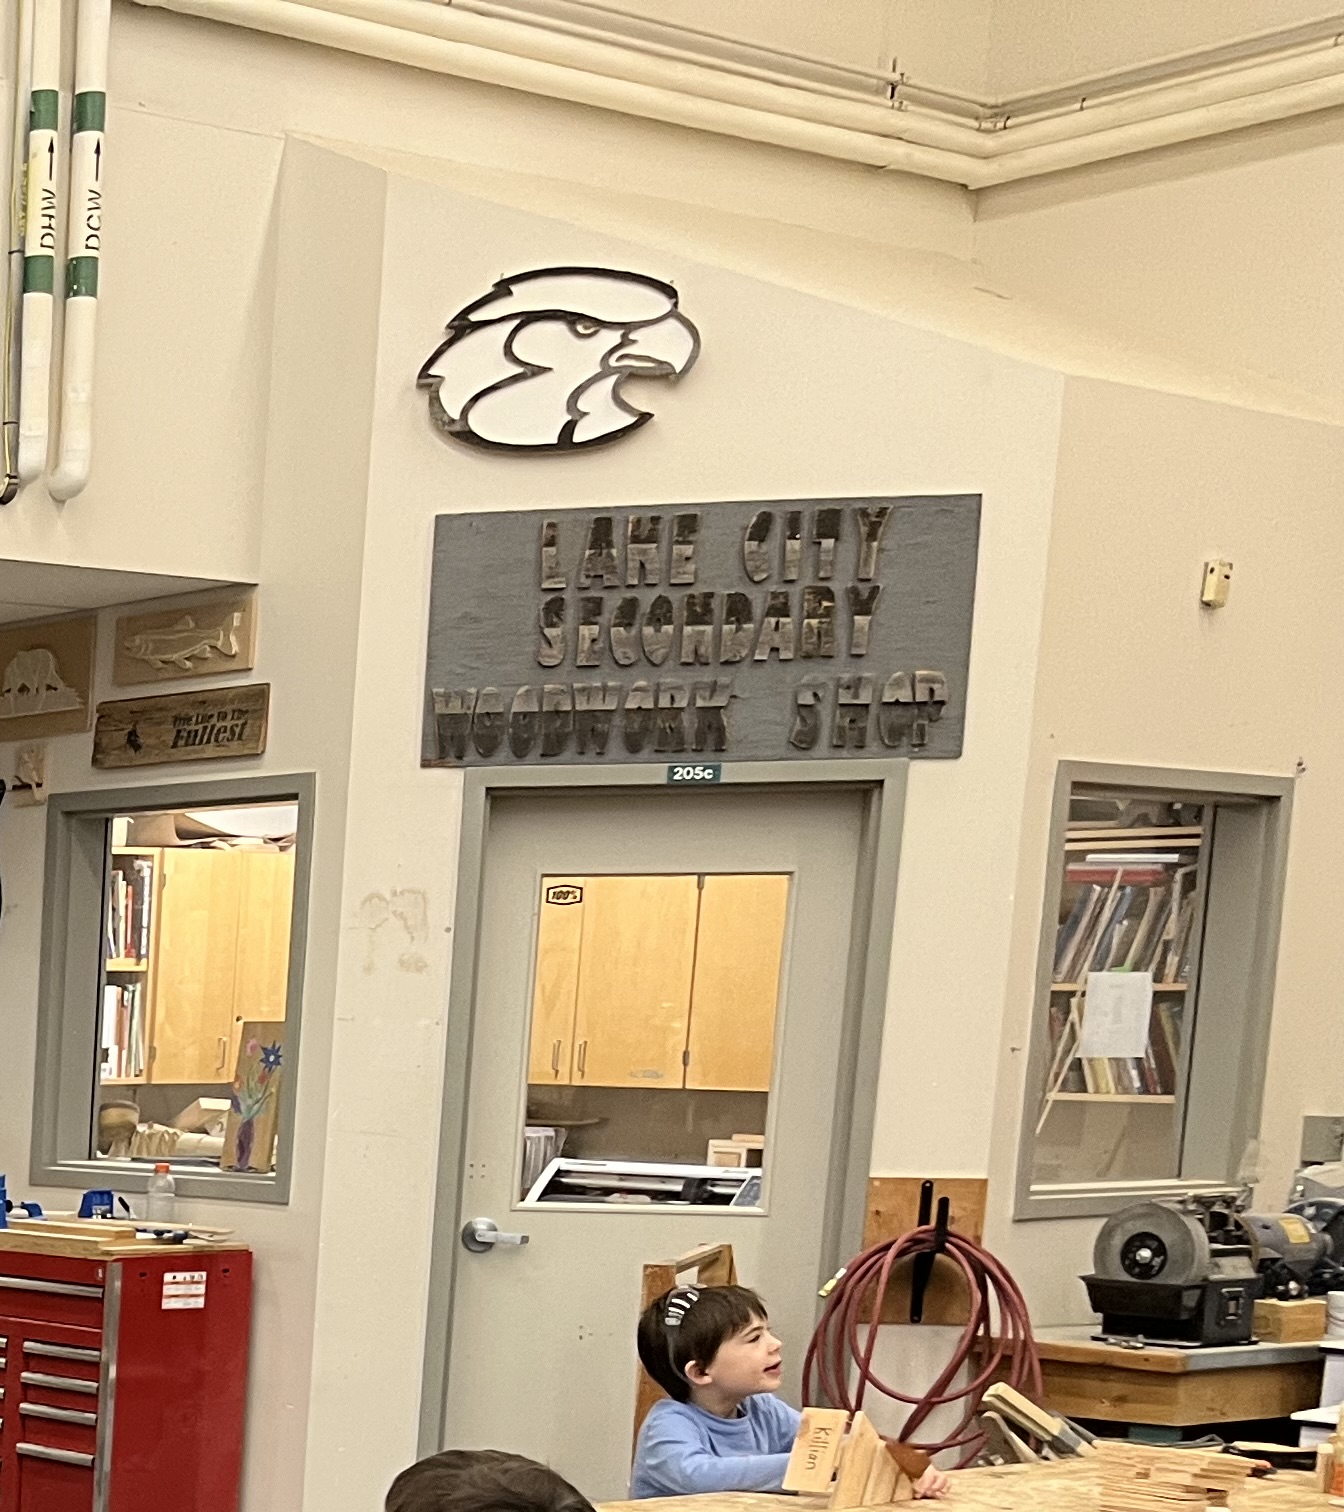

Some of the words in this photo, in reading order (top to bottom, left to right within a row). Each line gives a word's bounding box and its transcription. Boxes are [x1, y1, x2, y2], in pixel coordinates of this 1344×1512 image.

[40, 188, 56, 250] DHW
[85, 189, 102, 251] DCW
[539, 512, 702, 591] LAKE
[743, 506, 892, 584] CITY
[537, 584, 884, 668] SECONDARY
[170, 720, 249, 749] Fullest
[430, 677, 735, 759] WOODWORK
[788, 669, 950, 750] SHOP
[673, 766, 713, 780] 205c
[805, 1426, 833, 1471] Killian
